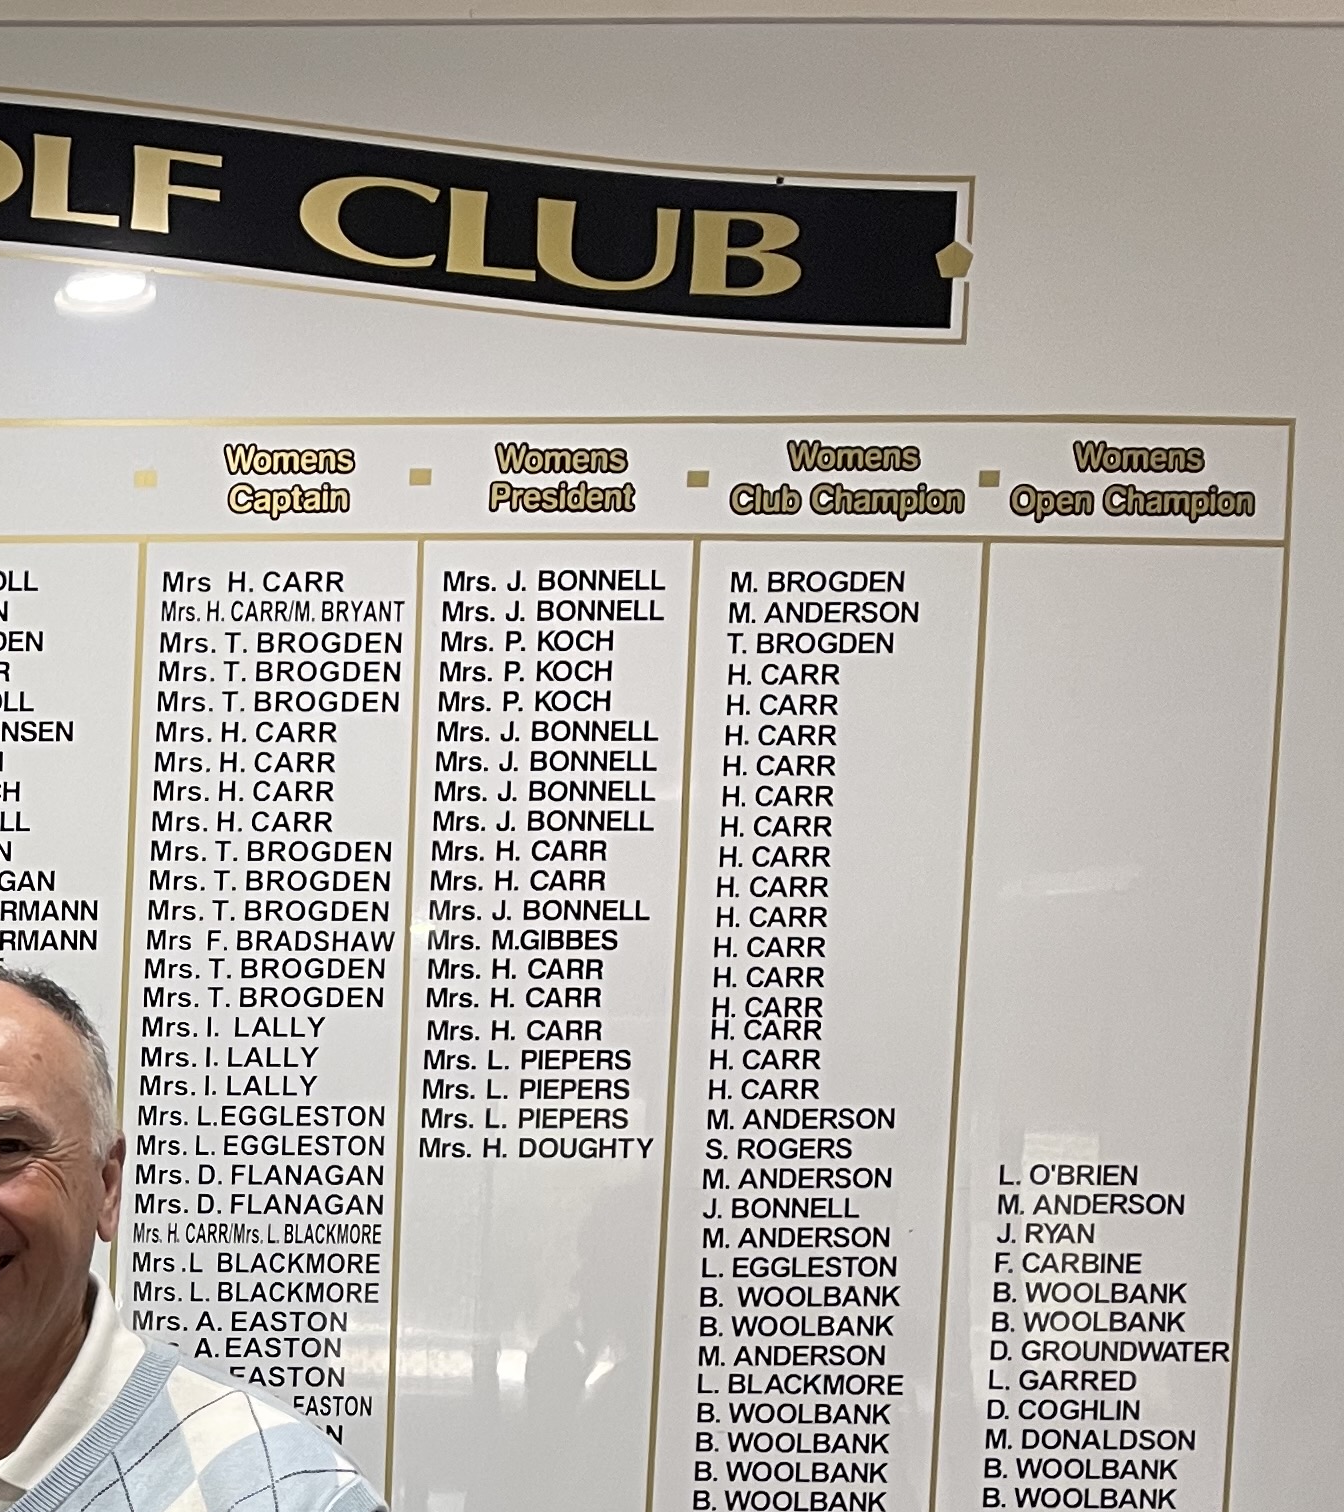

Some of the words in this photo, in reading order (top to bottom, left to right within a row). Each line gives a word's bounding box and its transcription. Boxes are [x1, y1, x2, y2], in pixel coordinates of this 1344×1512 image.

[299, 175, 802, 297] CLUB
[224, 443, 356, 475] Womens
[495, 442, 628, 474] Womens
[785, 439, 922, 472] Womens
[1072, 440, 1206, 472] Womens
[227, 482, 351, 520] Captain
[488, 480, 636, 513] President
[729, 485, 802, 515] Club
[809, 486, 966, 522] Champion
[1009, 486, 1094, 522] Open
[1102, 485, 1257, 520] Champion
[443, 570, 497, 592] Mrs.
[506, 569, 527, 592] J.
[537, 569, 666, 592] BONNELL
[728, 601, 756, 624] M.
[763, 601, 920, 624] ANDERSON
[159, 631, 216, 654] Mrs.
[224, 631, 248, 654] T.
[256, 631, 403, 654] BROGDEN
[440, 630, 494, 653] Mrs.
[505, 630, 526, 652] P.
[537, 629, 614, 652] KOCH
[140, 1046, 197, 1068] Mrs.
[205, 1046, 219, 1068] I.
[227, 1046, 320, 1068] LALLY
[135, 1163, 190, 1185] Mrs.
[198, 1163, 223, 1186] D.
[231, 1163, 384, 1186] FLANAGAN
[989, 1339, 1013, 1362] D.
[1021, 1339, 1230, 1363] GROUNDWATER
[697, 1373, 720, 1394] L.
[727, 1373, 904, 1396] BLACKMORE
